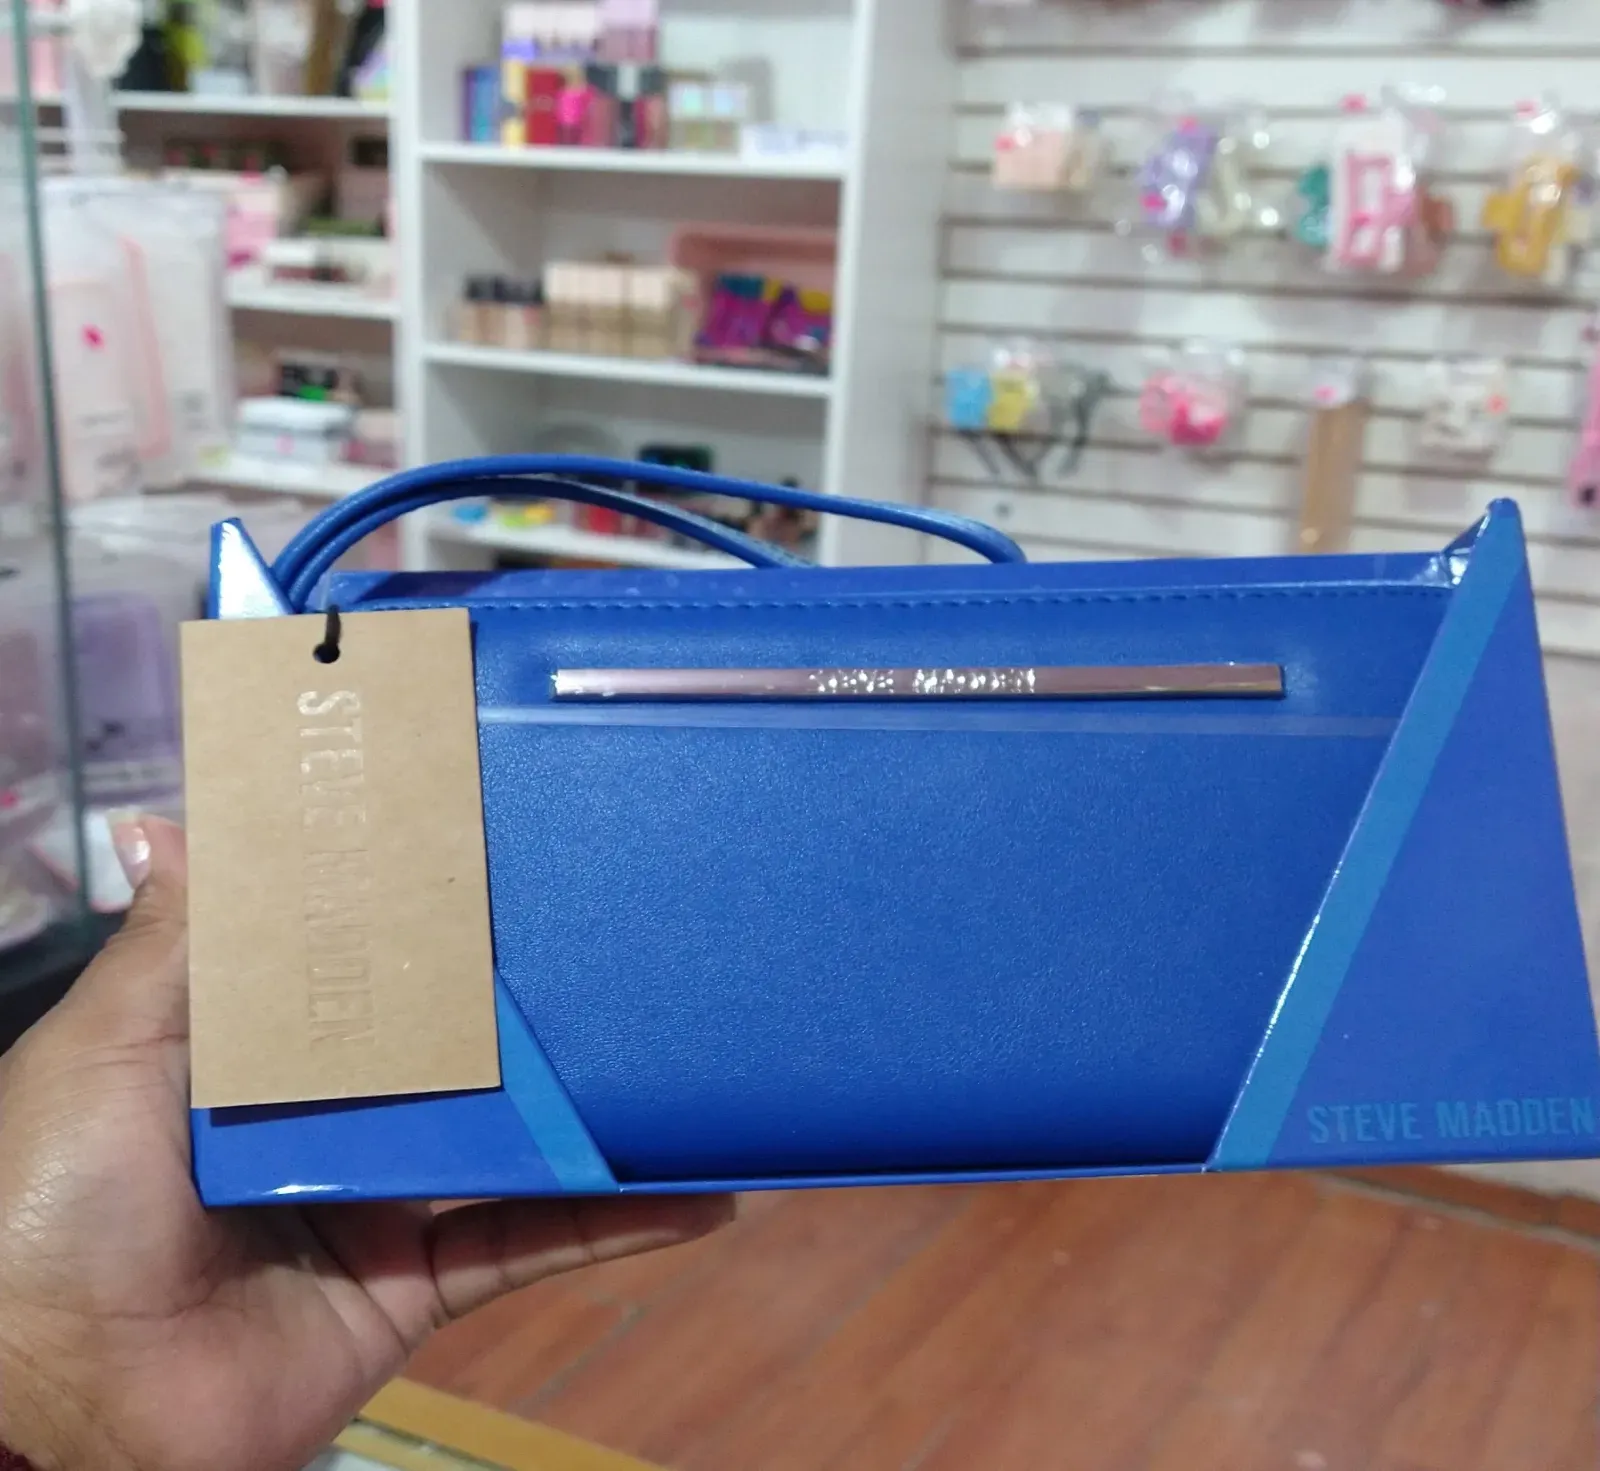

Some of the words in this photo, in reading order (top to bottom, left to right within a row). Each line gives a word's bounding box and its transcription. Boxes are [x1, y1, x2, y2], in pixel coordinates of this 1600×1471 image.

[297, 690, 366, 832] STEVE
[1306, 1102, 1423, 1144] STEVE
[1434, 1097, 1595, 1138] MADDEN
